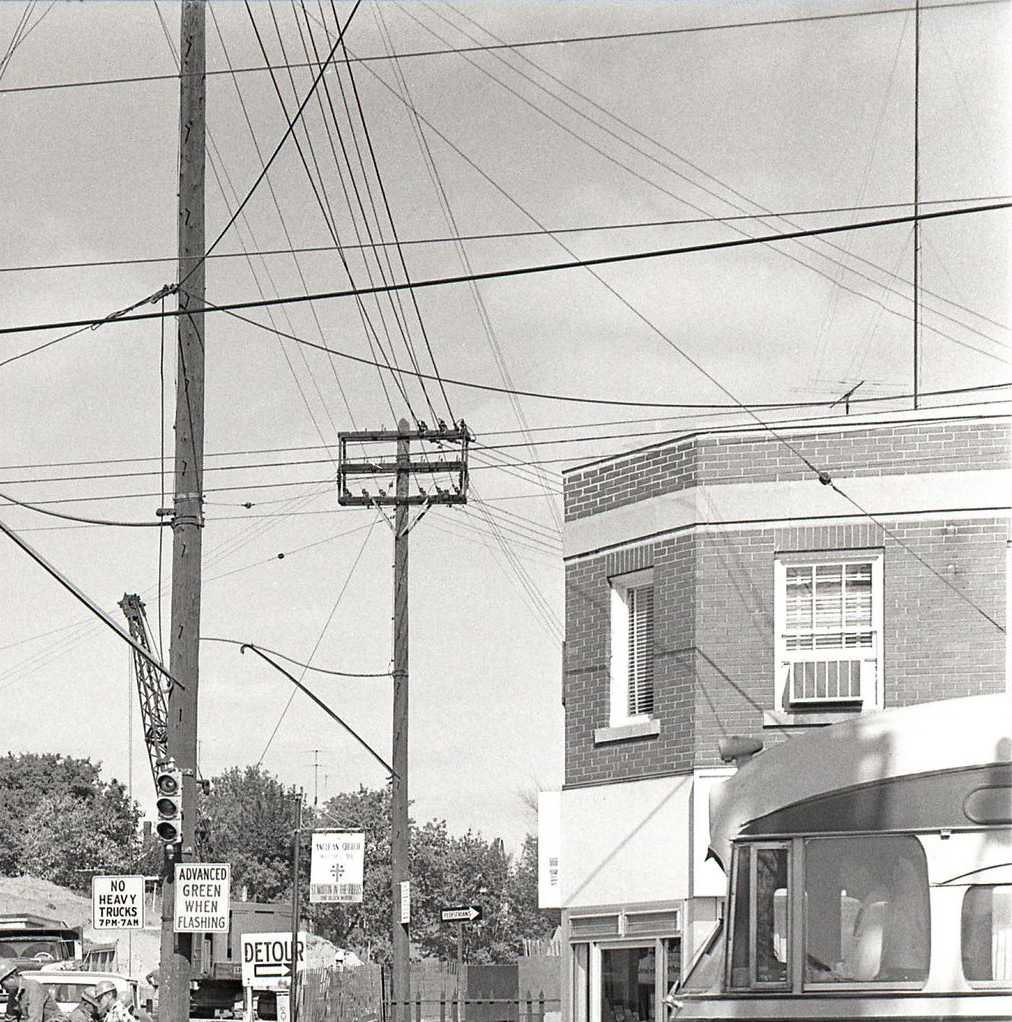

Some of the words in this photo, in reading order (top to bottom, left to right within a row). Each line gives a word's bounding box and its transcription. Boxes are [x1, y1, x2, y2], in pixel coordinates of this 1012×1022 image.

[179, 867, 227, 881] ADVANCED
[110, 880, 126, 892] NO
[182, 884, 221, 898] GREEN
[99, 894, 137, 905] HEAVY
[99, 906, 137, 917] TRUCKS
[185, 900, 218, 913] WHEN
[178, 916, 225, 929] FLASHING
[244, 941, 304, 963] DETOUR
